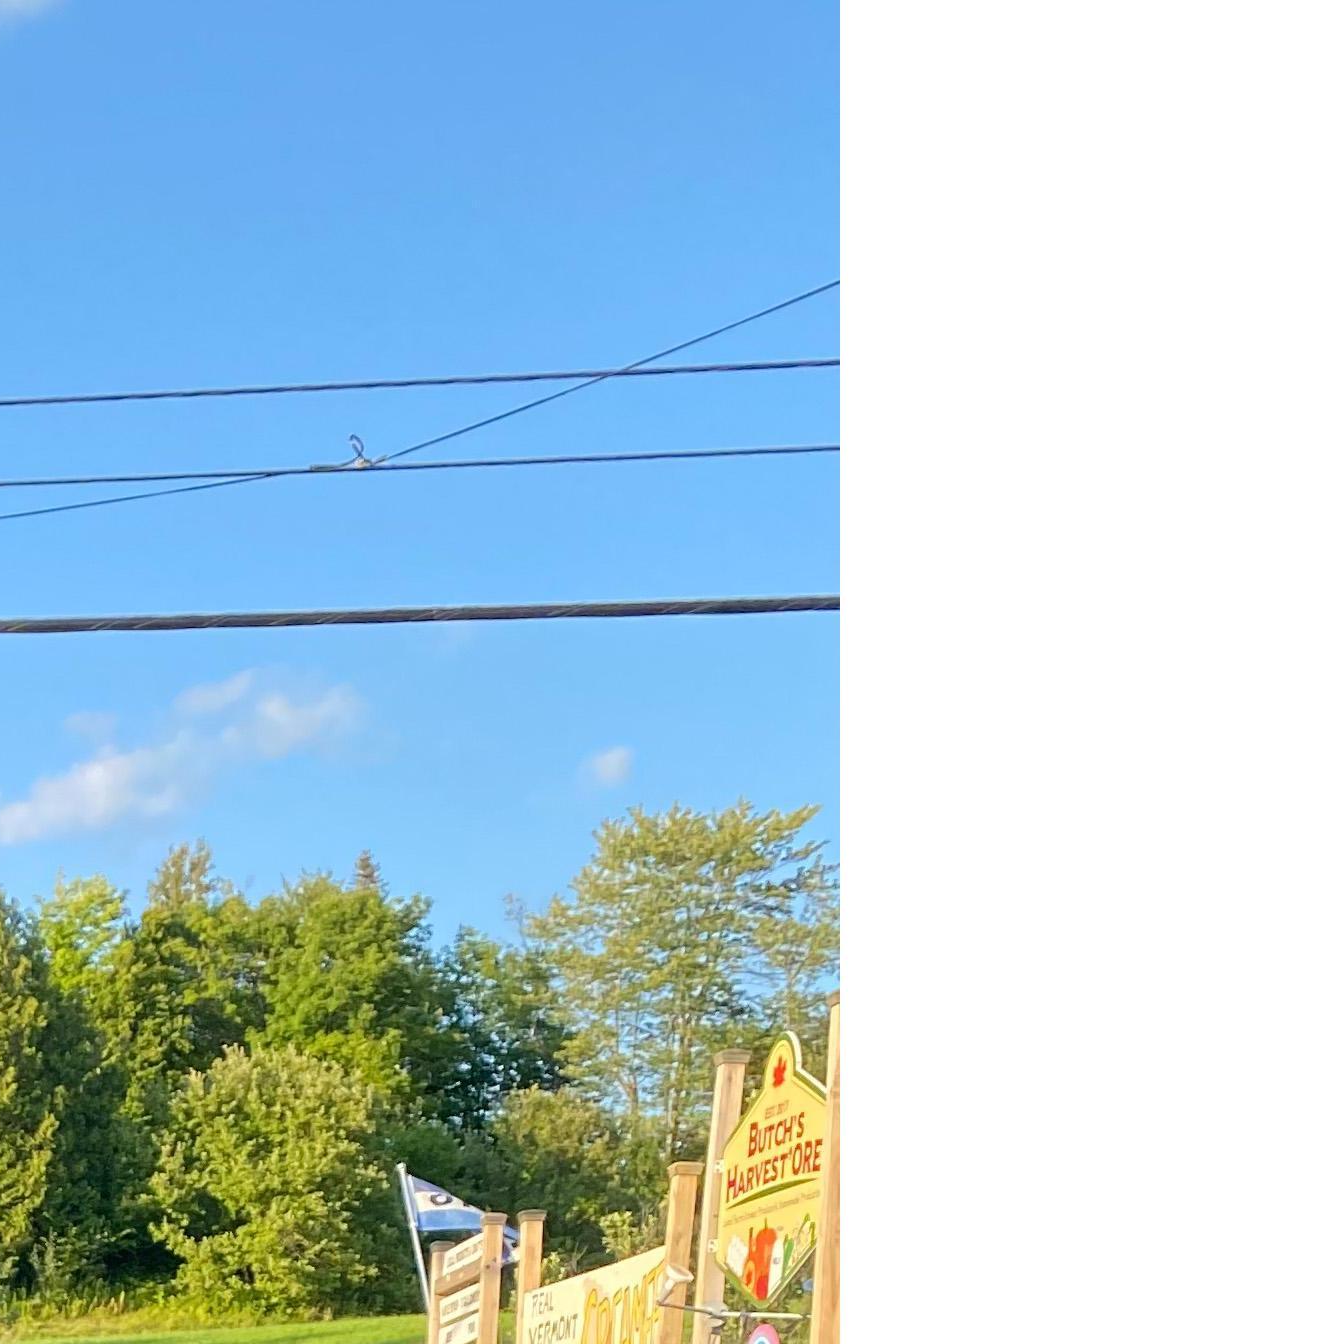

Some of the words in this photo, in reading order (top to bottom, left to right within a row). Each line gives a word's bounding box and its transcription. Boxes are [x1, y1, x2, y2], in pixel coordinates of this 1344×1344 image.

[748, 1111, 805, 1158] BUTCH'S
[726, 1138, 824, 1203] HARVEST'ORE
[532, 1291, 554, 1318] REAL
